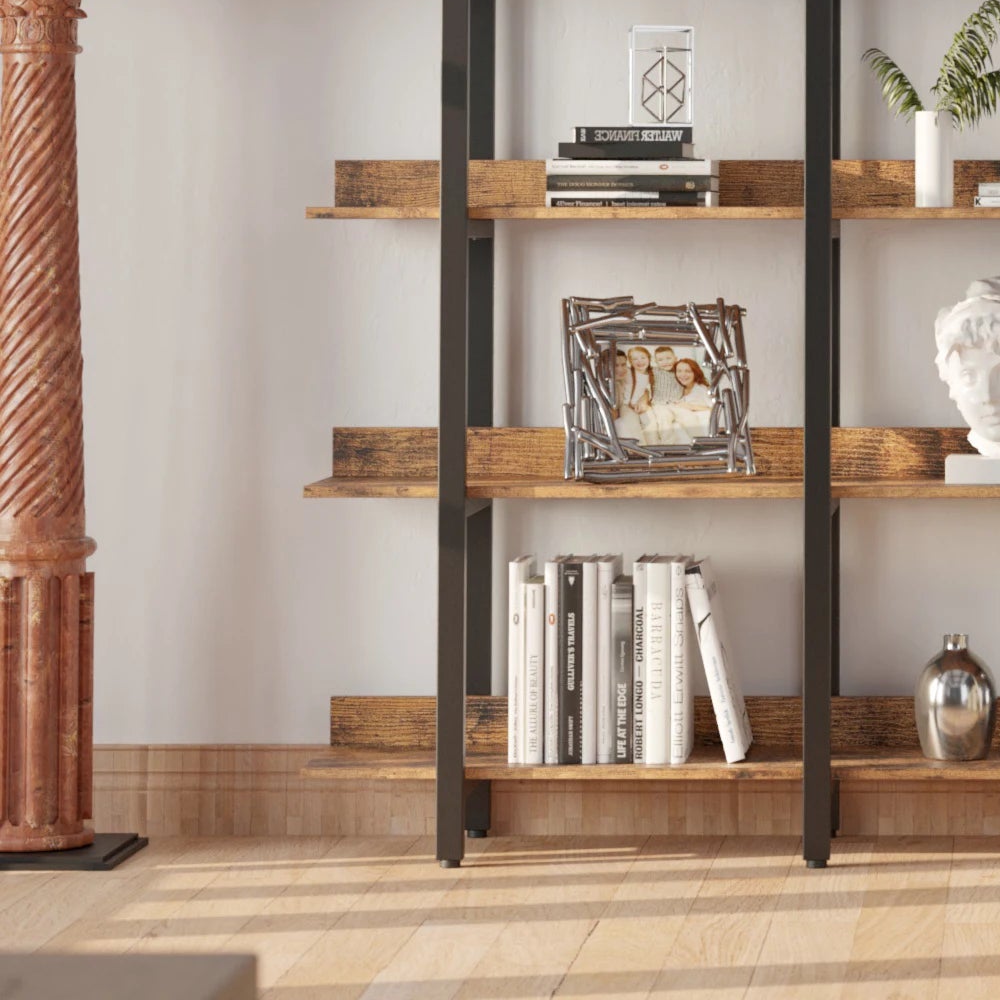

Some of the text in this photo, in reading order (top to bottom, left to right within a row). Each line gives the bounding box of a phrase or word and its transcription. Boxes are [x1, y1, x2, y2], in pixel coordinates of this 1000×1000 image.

[567, 612, 576, 691] GULLIVER'S TRAVELS
[635, 606, 643, 759] ROBERT LONGO CHARCOAL
[650, 602, 663, 700] BARRACUDA
[529, 654, 538, 753] THE ALLURE OF BEAUTY
[617, 683, 627, 758] LIFE AT THE EDGE
